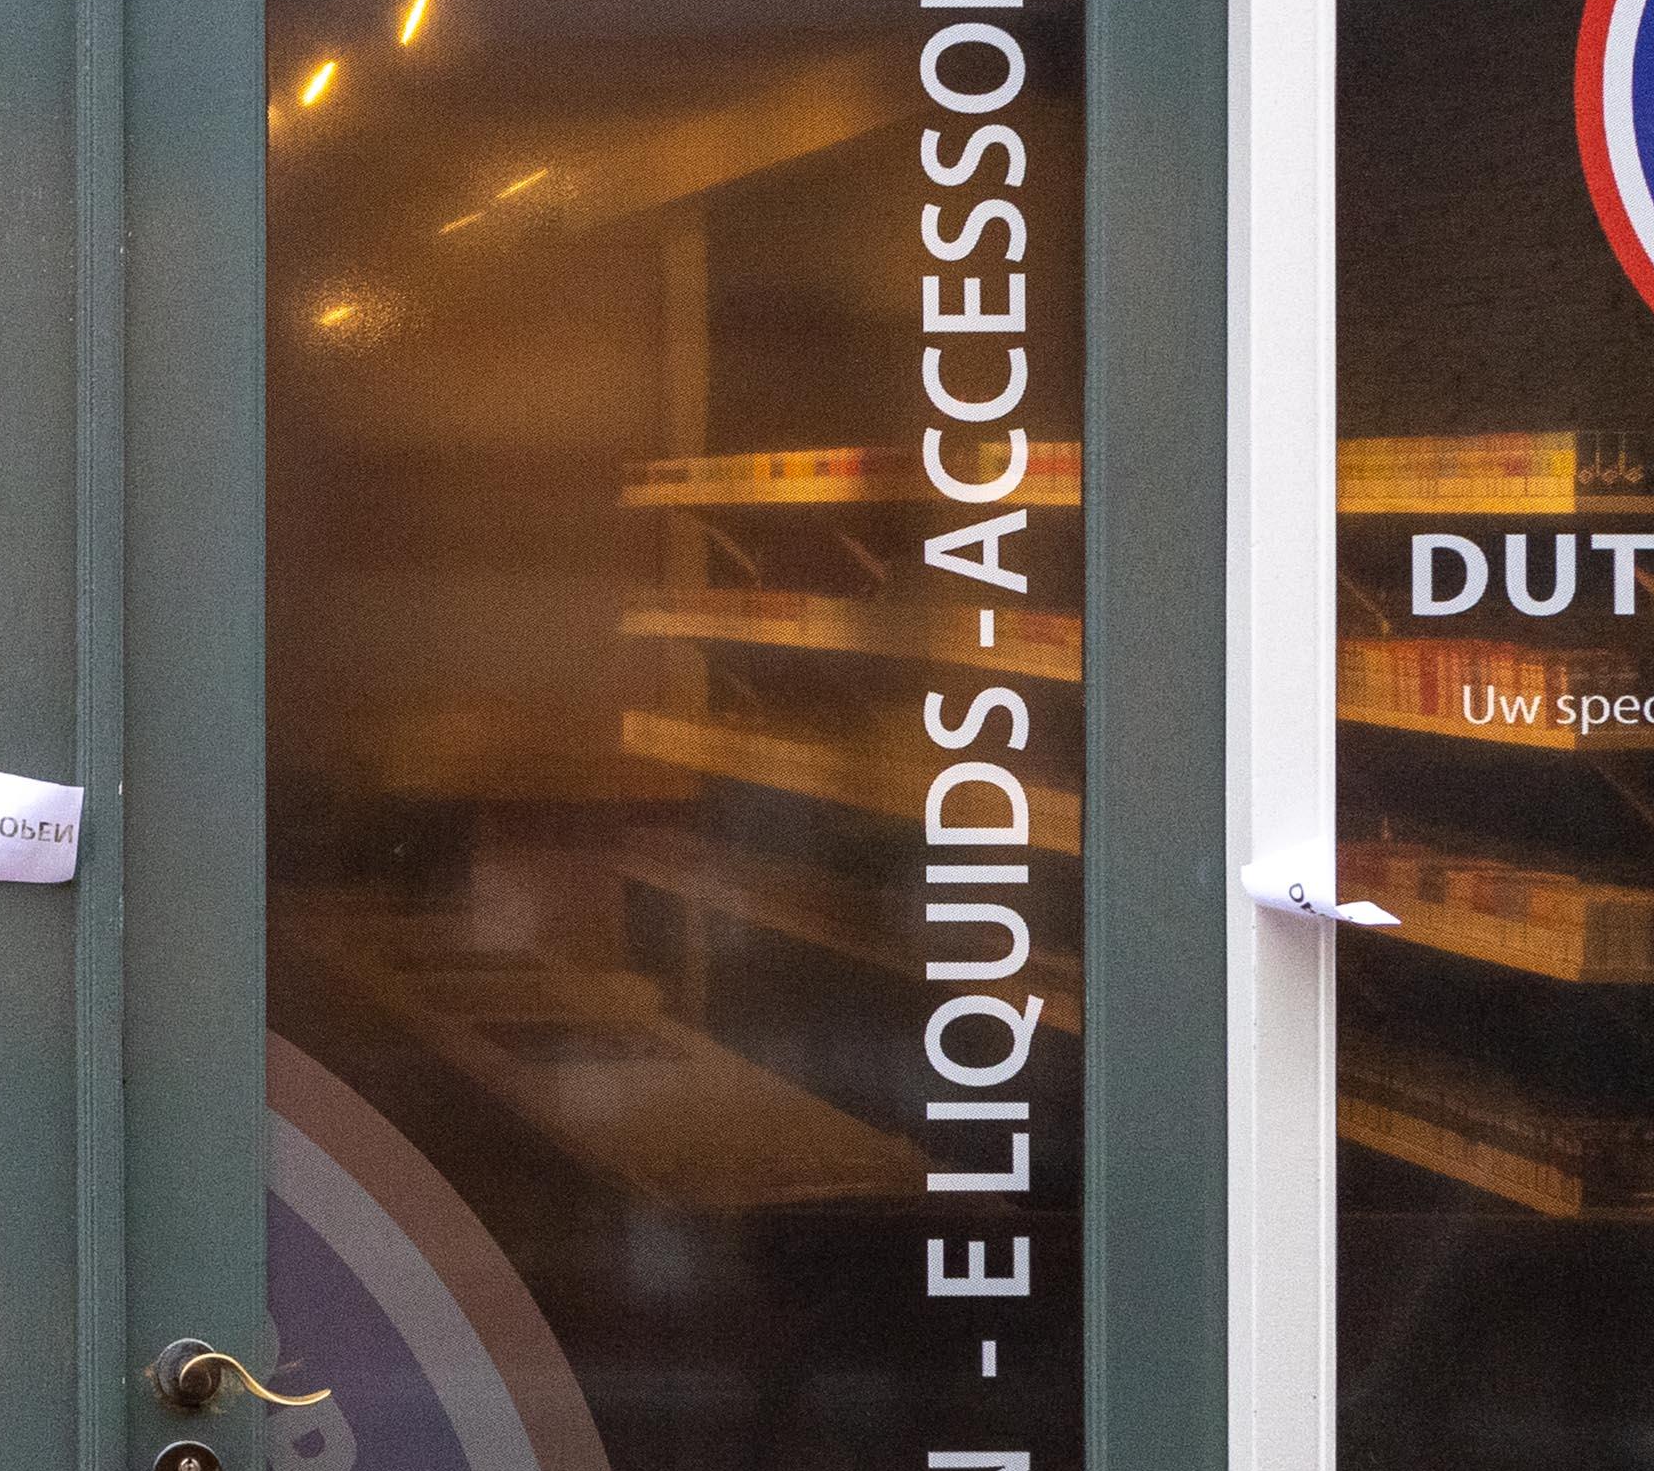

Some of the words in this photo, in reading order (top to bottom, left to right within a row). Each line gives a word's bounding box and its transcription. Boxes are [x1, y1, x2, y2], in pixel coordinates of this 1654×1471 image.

[1463, 685, 1541, 726] Uw
[923, 687, 1044, 1192] LIQUIDS
[927, 1236, 1030, 1297] E
